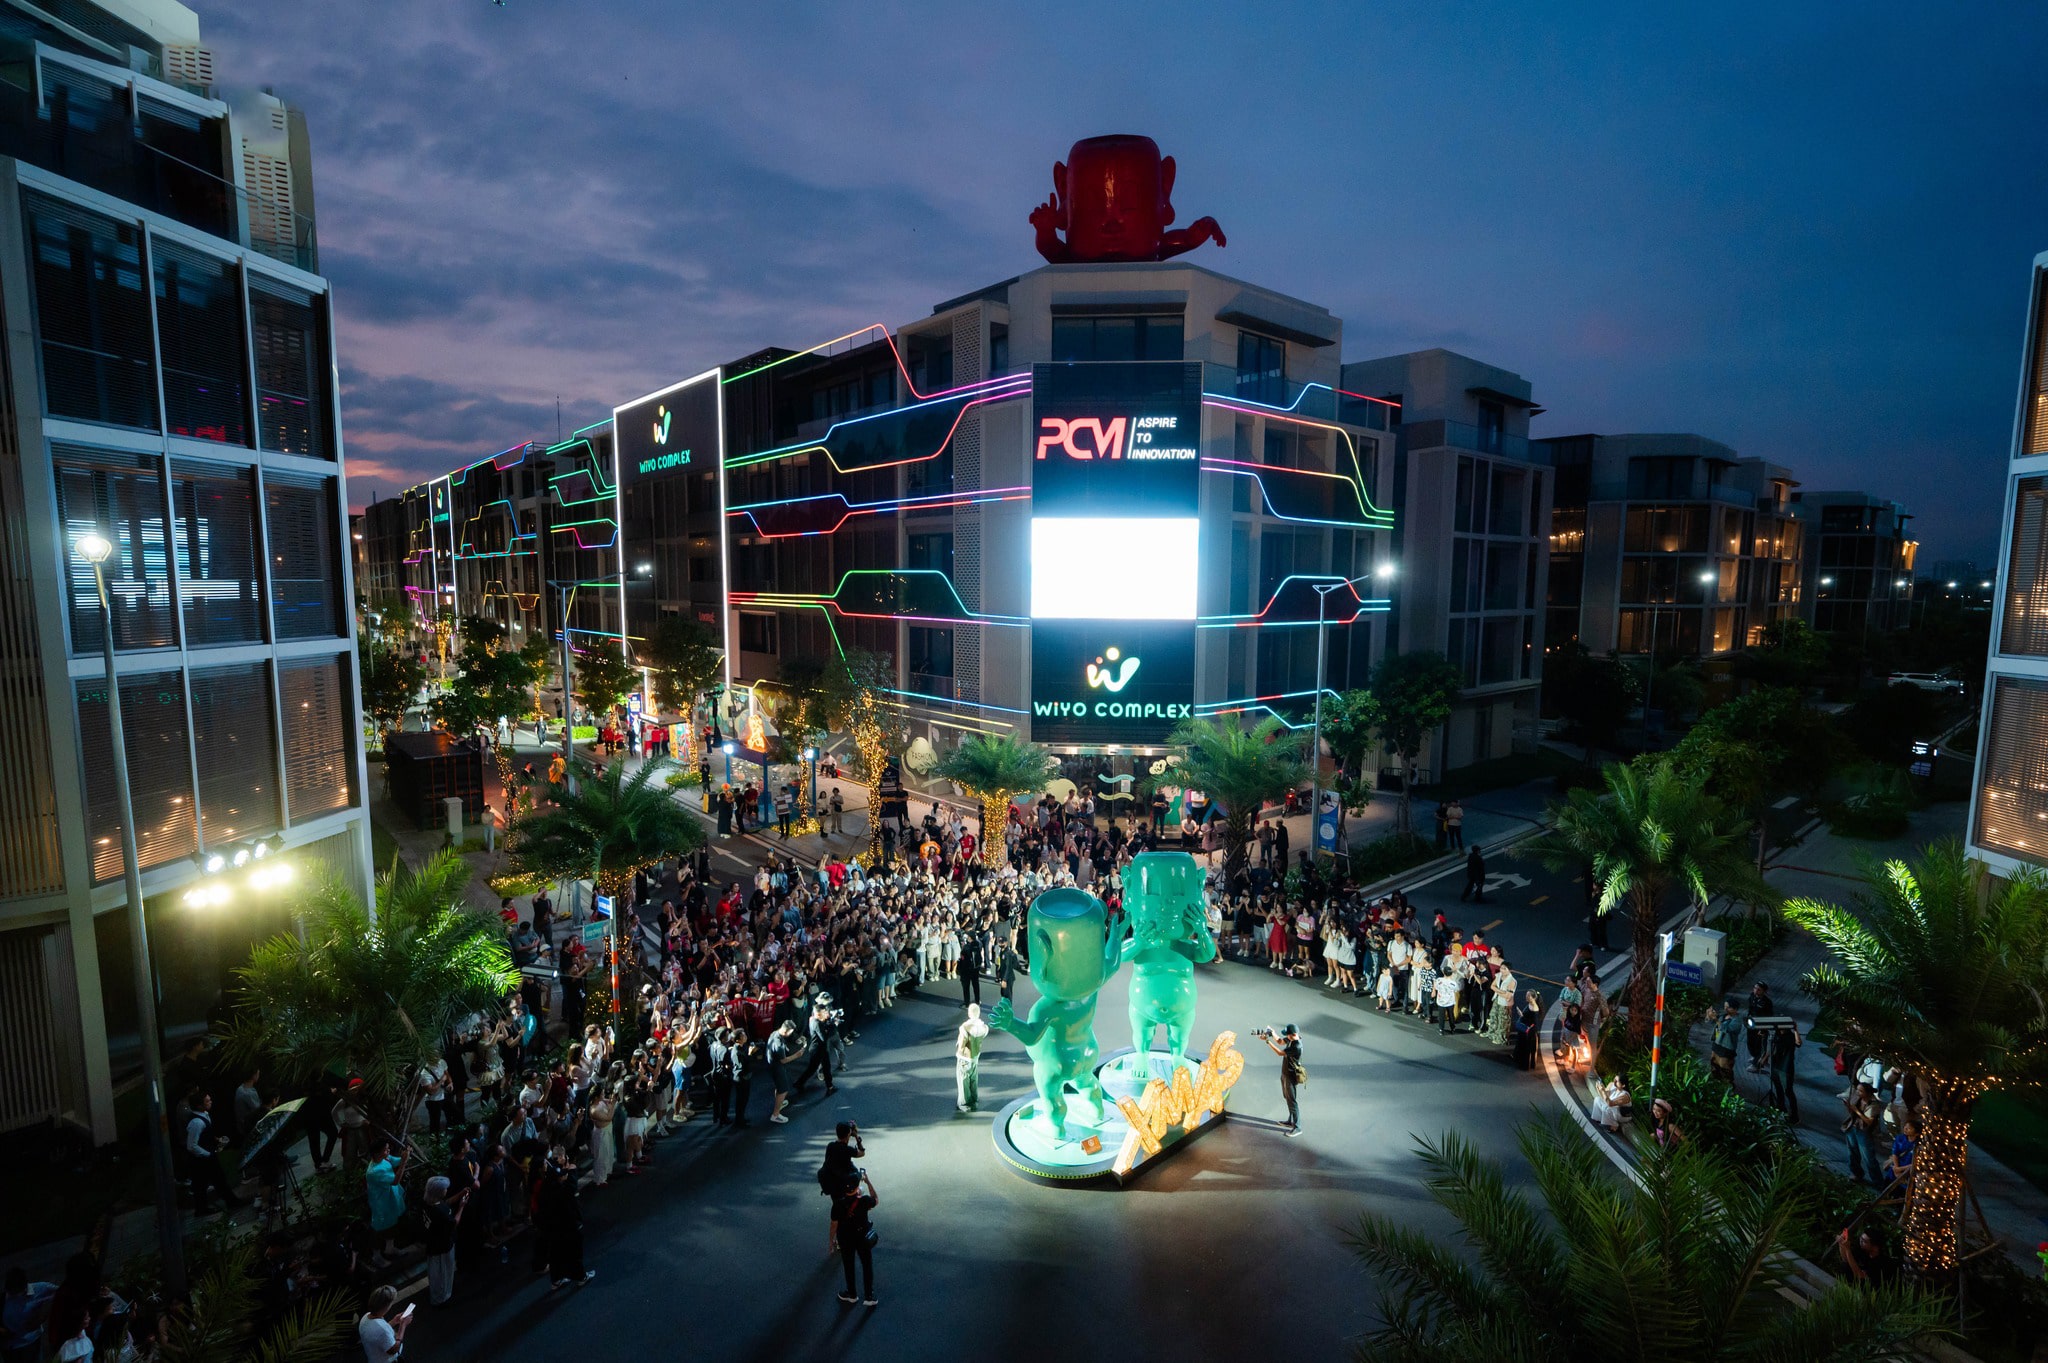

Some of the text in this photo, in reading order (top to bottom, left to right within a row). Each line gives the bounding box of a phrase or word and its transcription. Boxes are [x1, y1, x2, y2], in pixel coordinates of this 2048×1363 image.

[1137, 416, 1177, 428] ASPIRE
[1036, 417, 1127, 460] PCM
[1136, 432, 1152, 444] TO
[657, 449, 691, 470] COMPLEX
[1131, 448, 1196, 460] INNOVATION
[1094, 702, 1192, 719] COMPLEX
